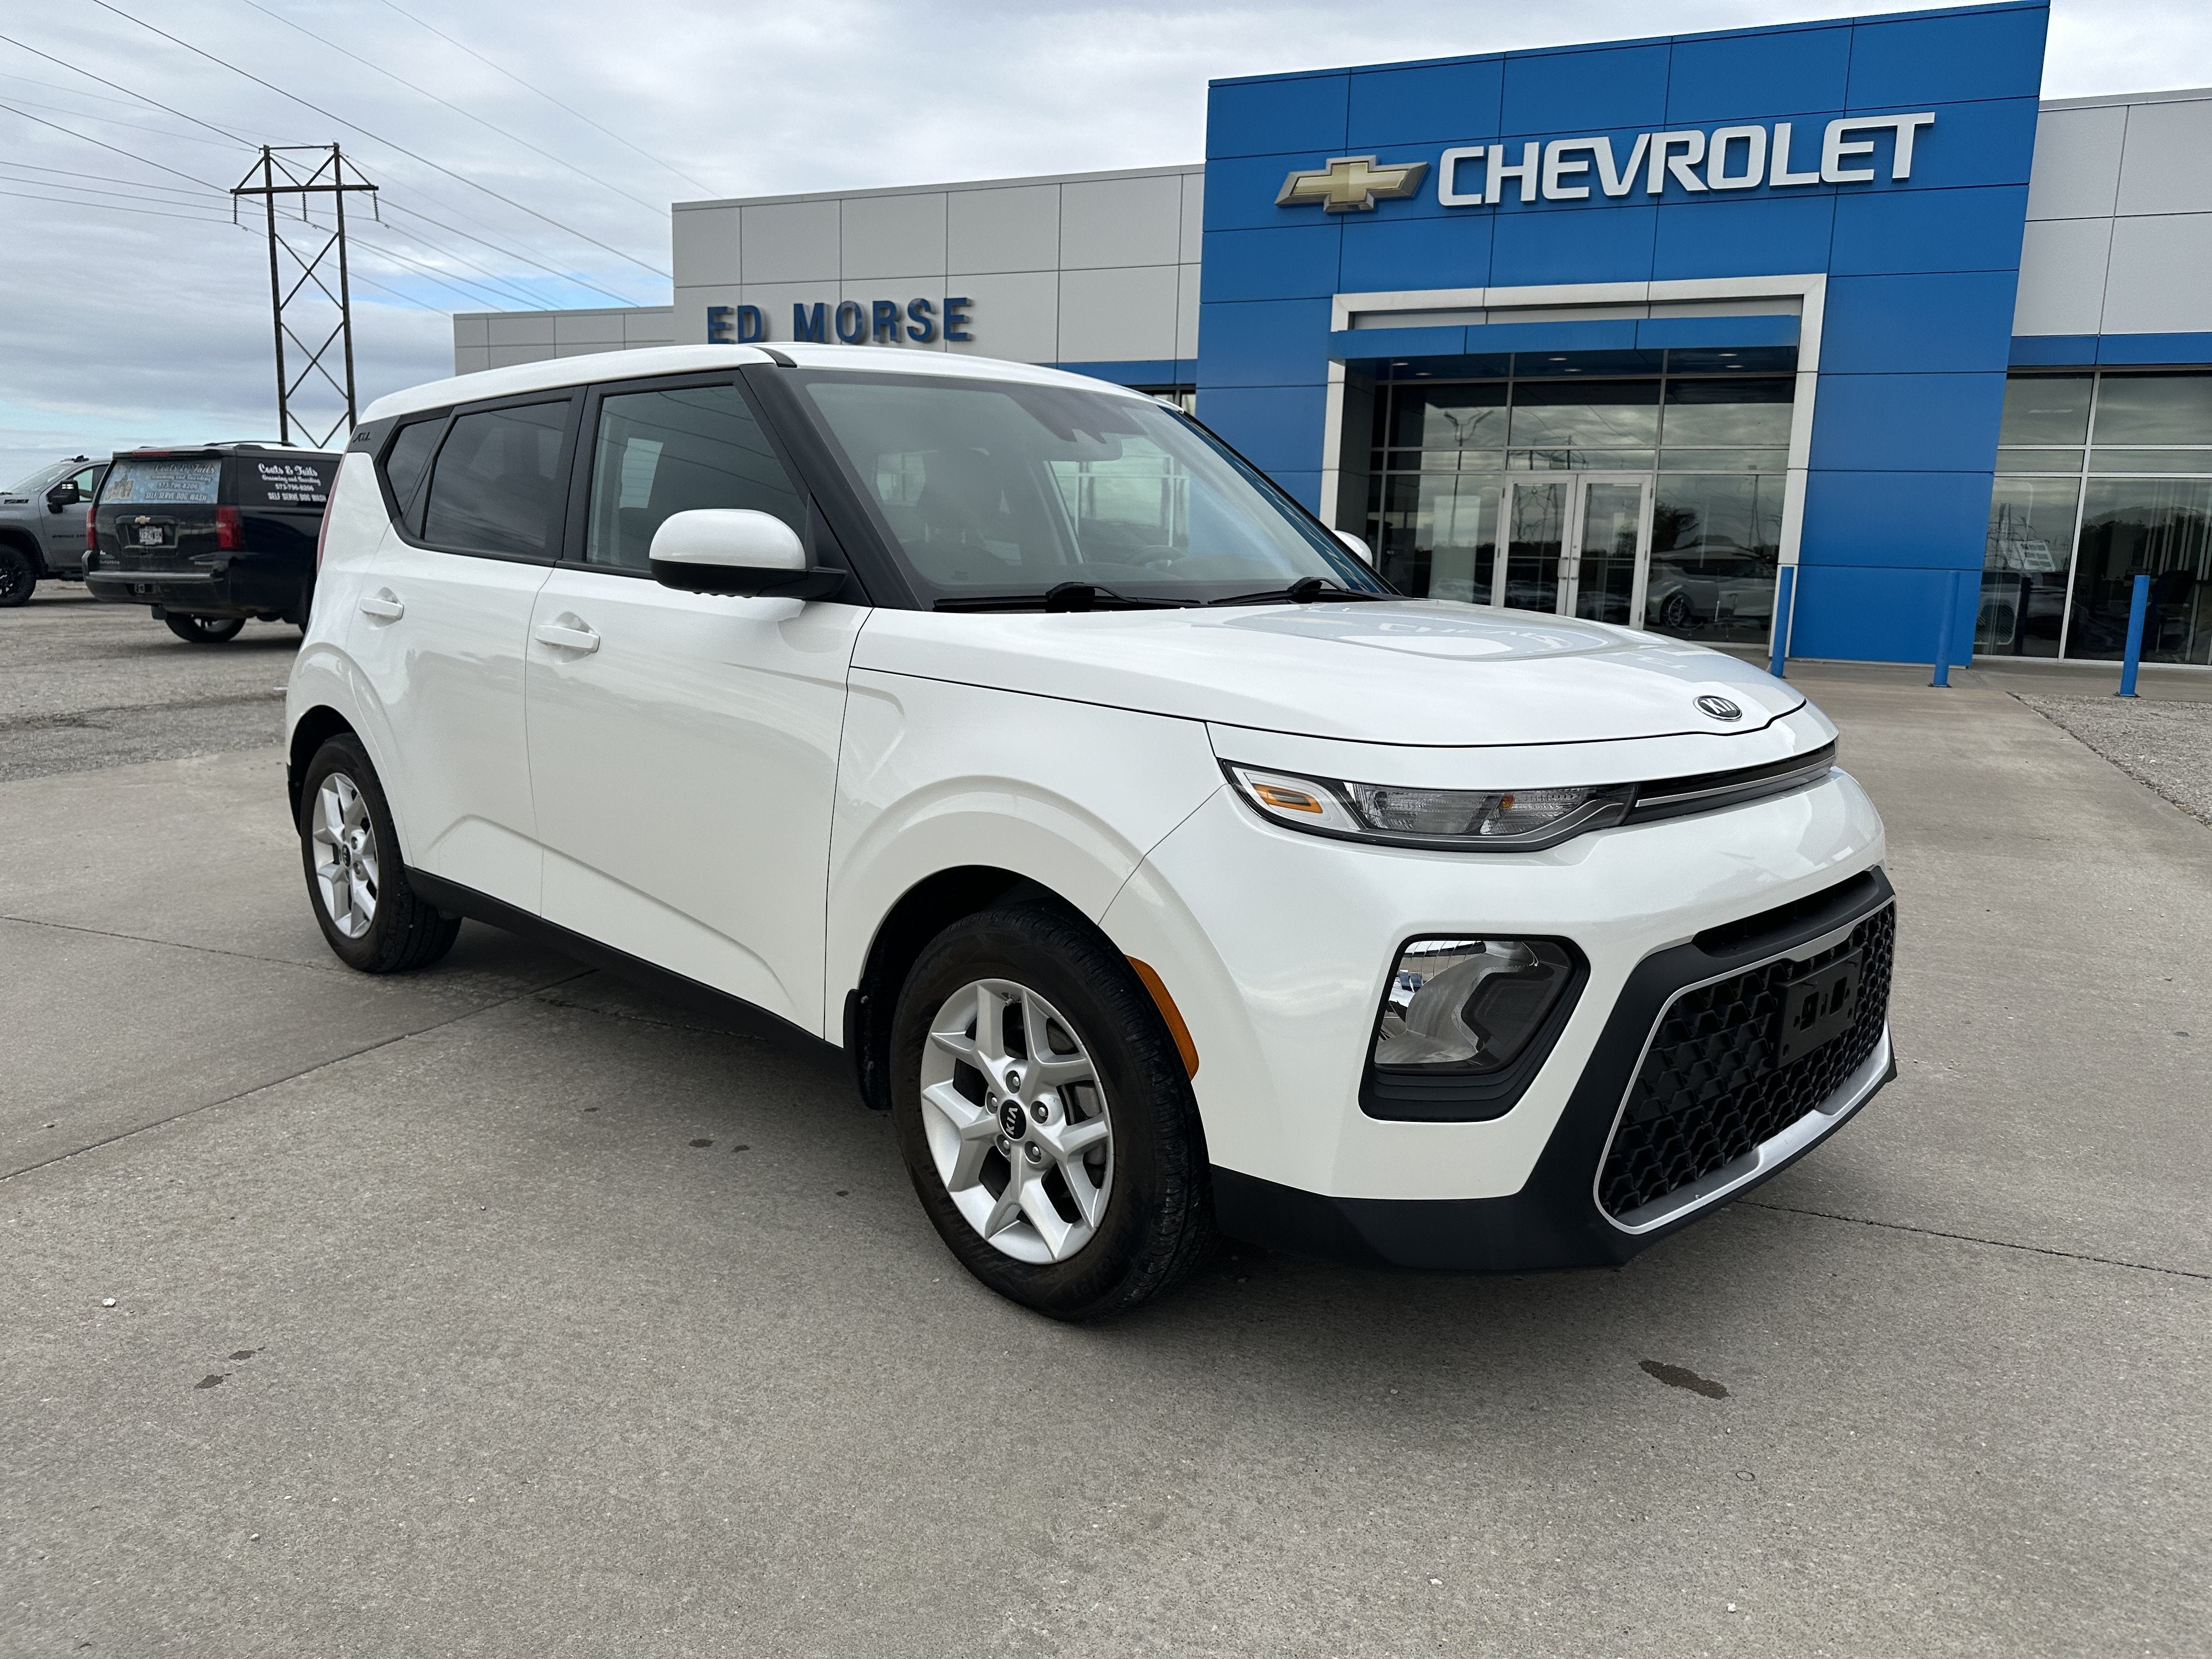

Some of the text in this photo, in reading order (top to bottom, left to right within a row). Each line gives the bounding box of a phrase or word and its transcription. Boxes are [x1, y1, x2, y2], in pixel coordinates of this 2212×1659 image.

[1437, 111, 1937, 207] CHEVROLET
[707, 297, 972, 345] ED MORSE
[189, 493, 207, 501] WASH
[1700, 697, 1735, 714] KIA
[1006, 1107, 1018, 1136] KIA
